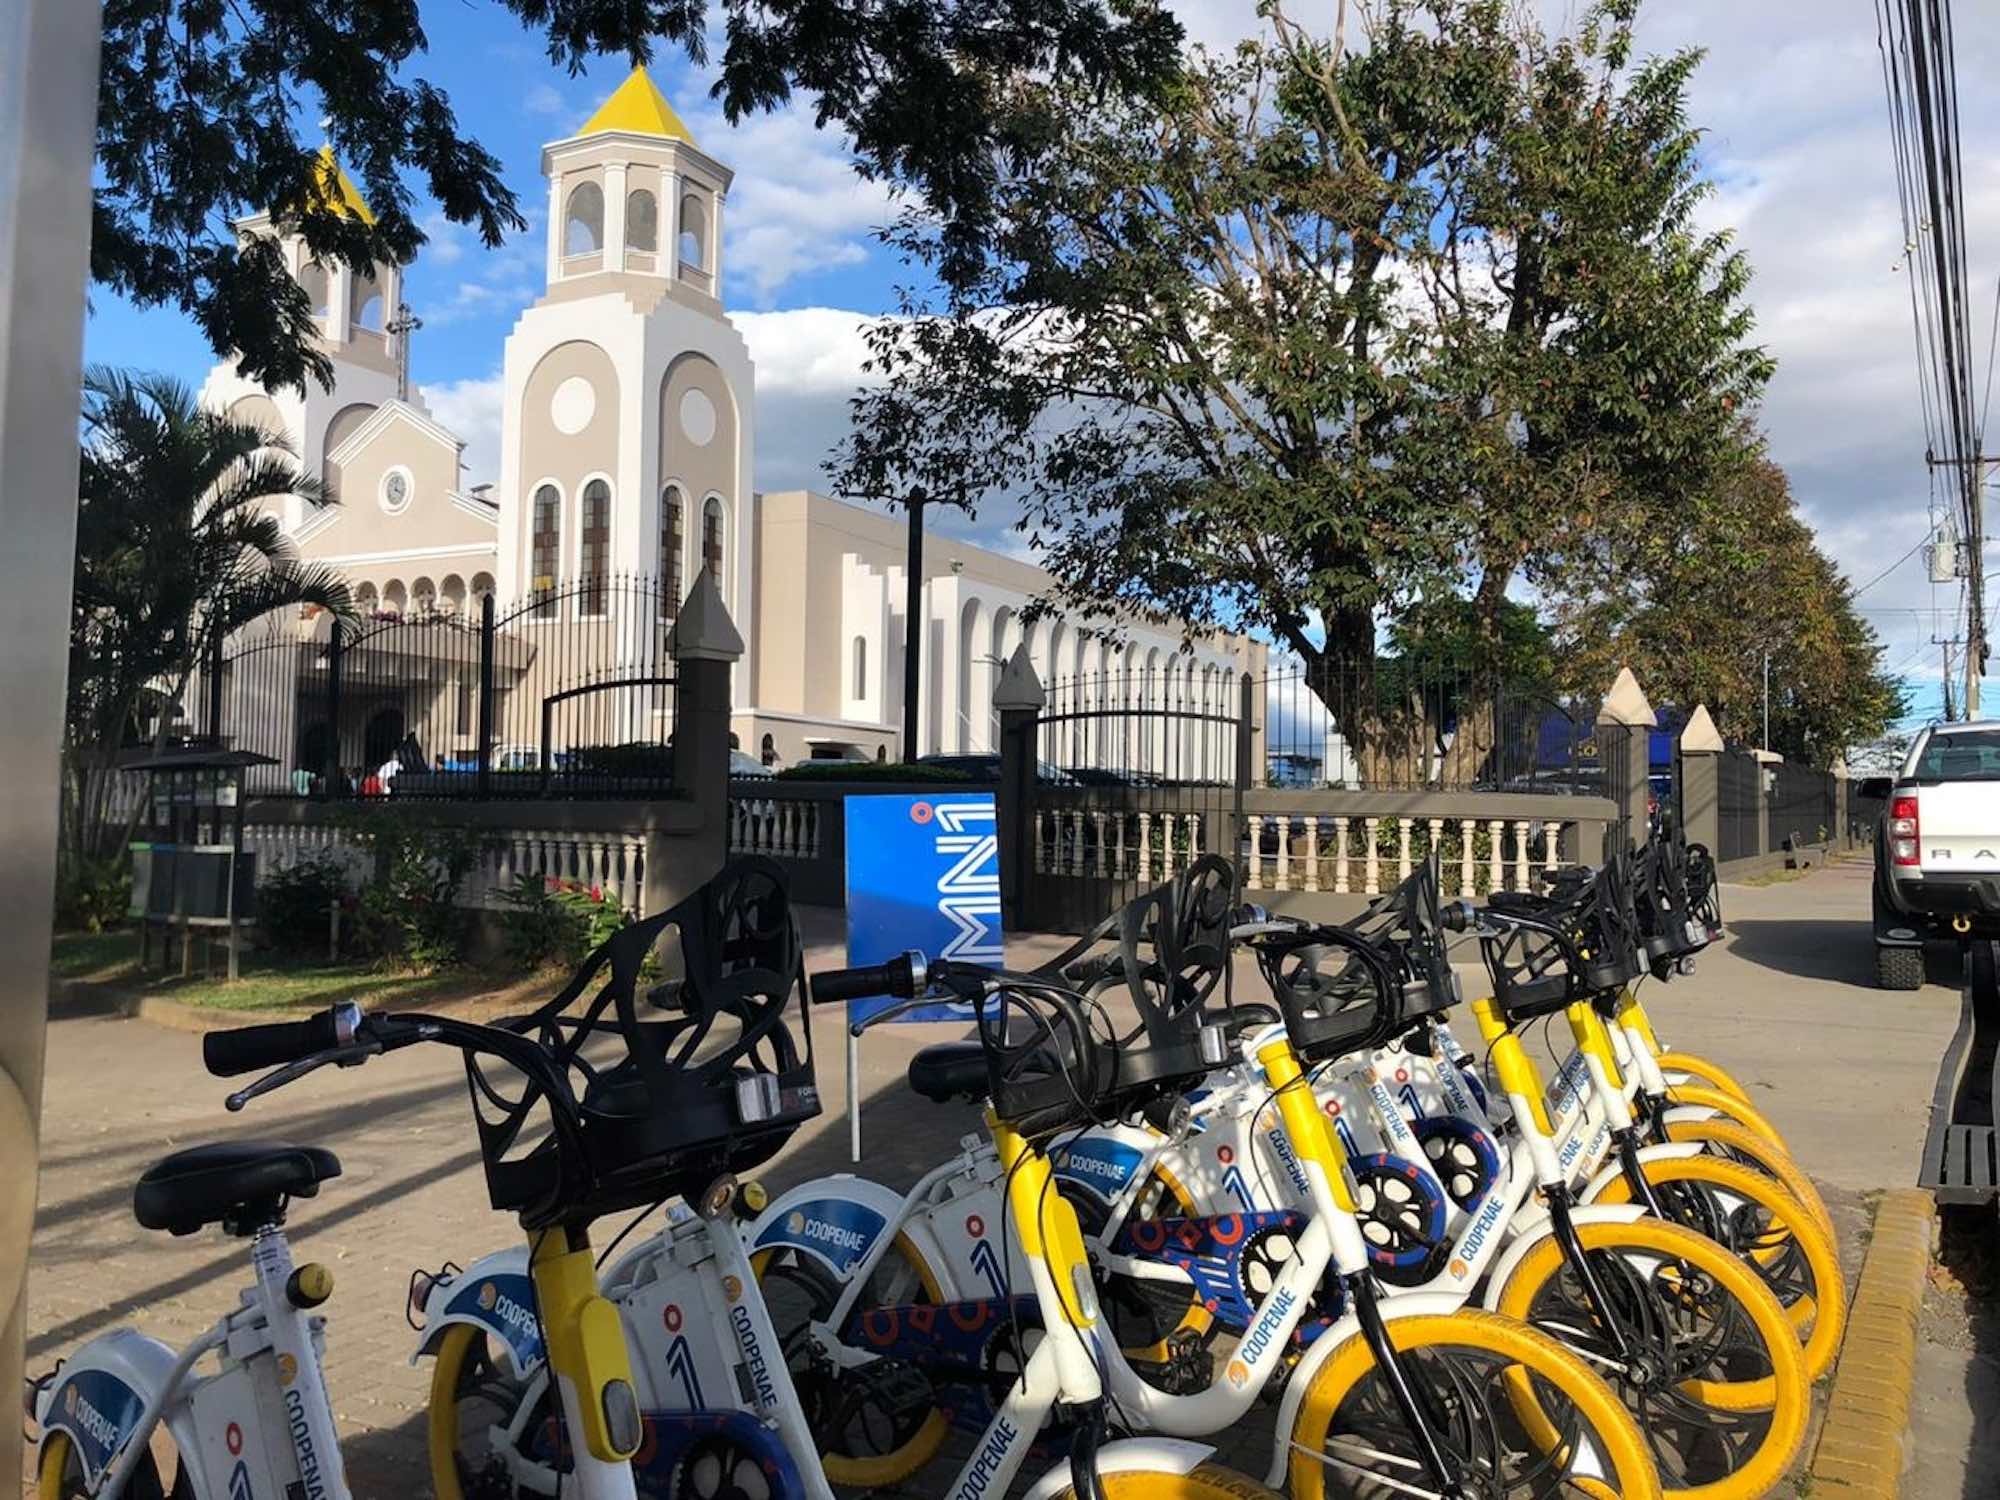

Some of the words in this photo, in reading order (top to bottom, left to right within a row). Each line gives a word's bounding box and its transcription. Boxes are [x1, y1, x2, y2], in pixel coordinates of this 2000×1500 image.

[1371, 1085, 1409, 1141] COOPENAE
[1071, 1155, 1126, 1180] COOPENAE
[1269, 1129, 1310, 1196] COOPENAE
[804, 1219, 866, 1251] COOPENAE
[1460, 1196, 1504, 1261] COOPENAE
[1241, 1286, 1296, 1364] COOPENAE
[732, 1305, 778, 1409] COOPENAE
[76, 1396, 119, 1450] COOPENAE
